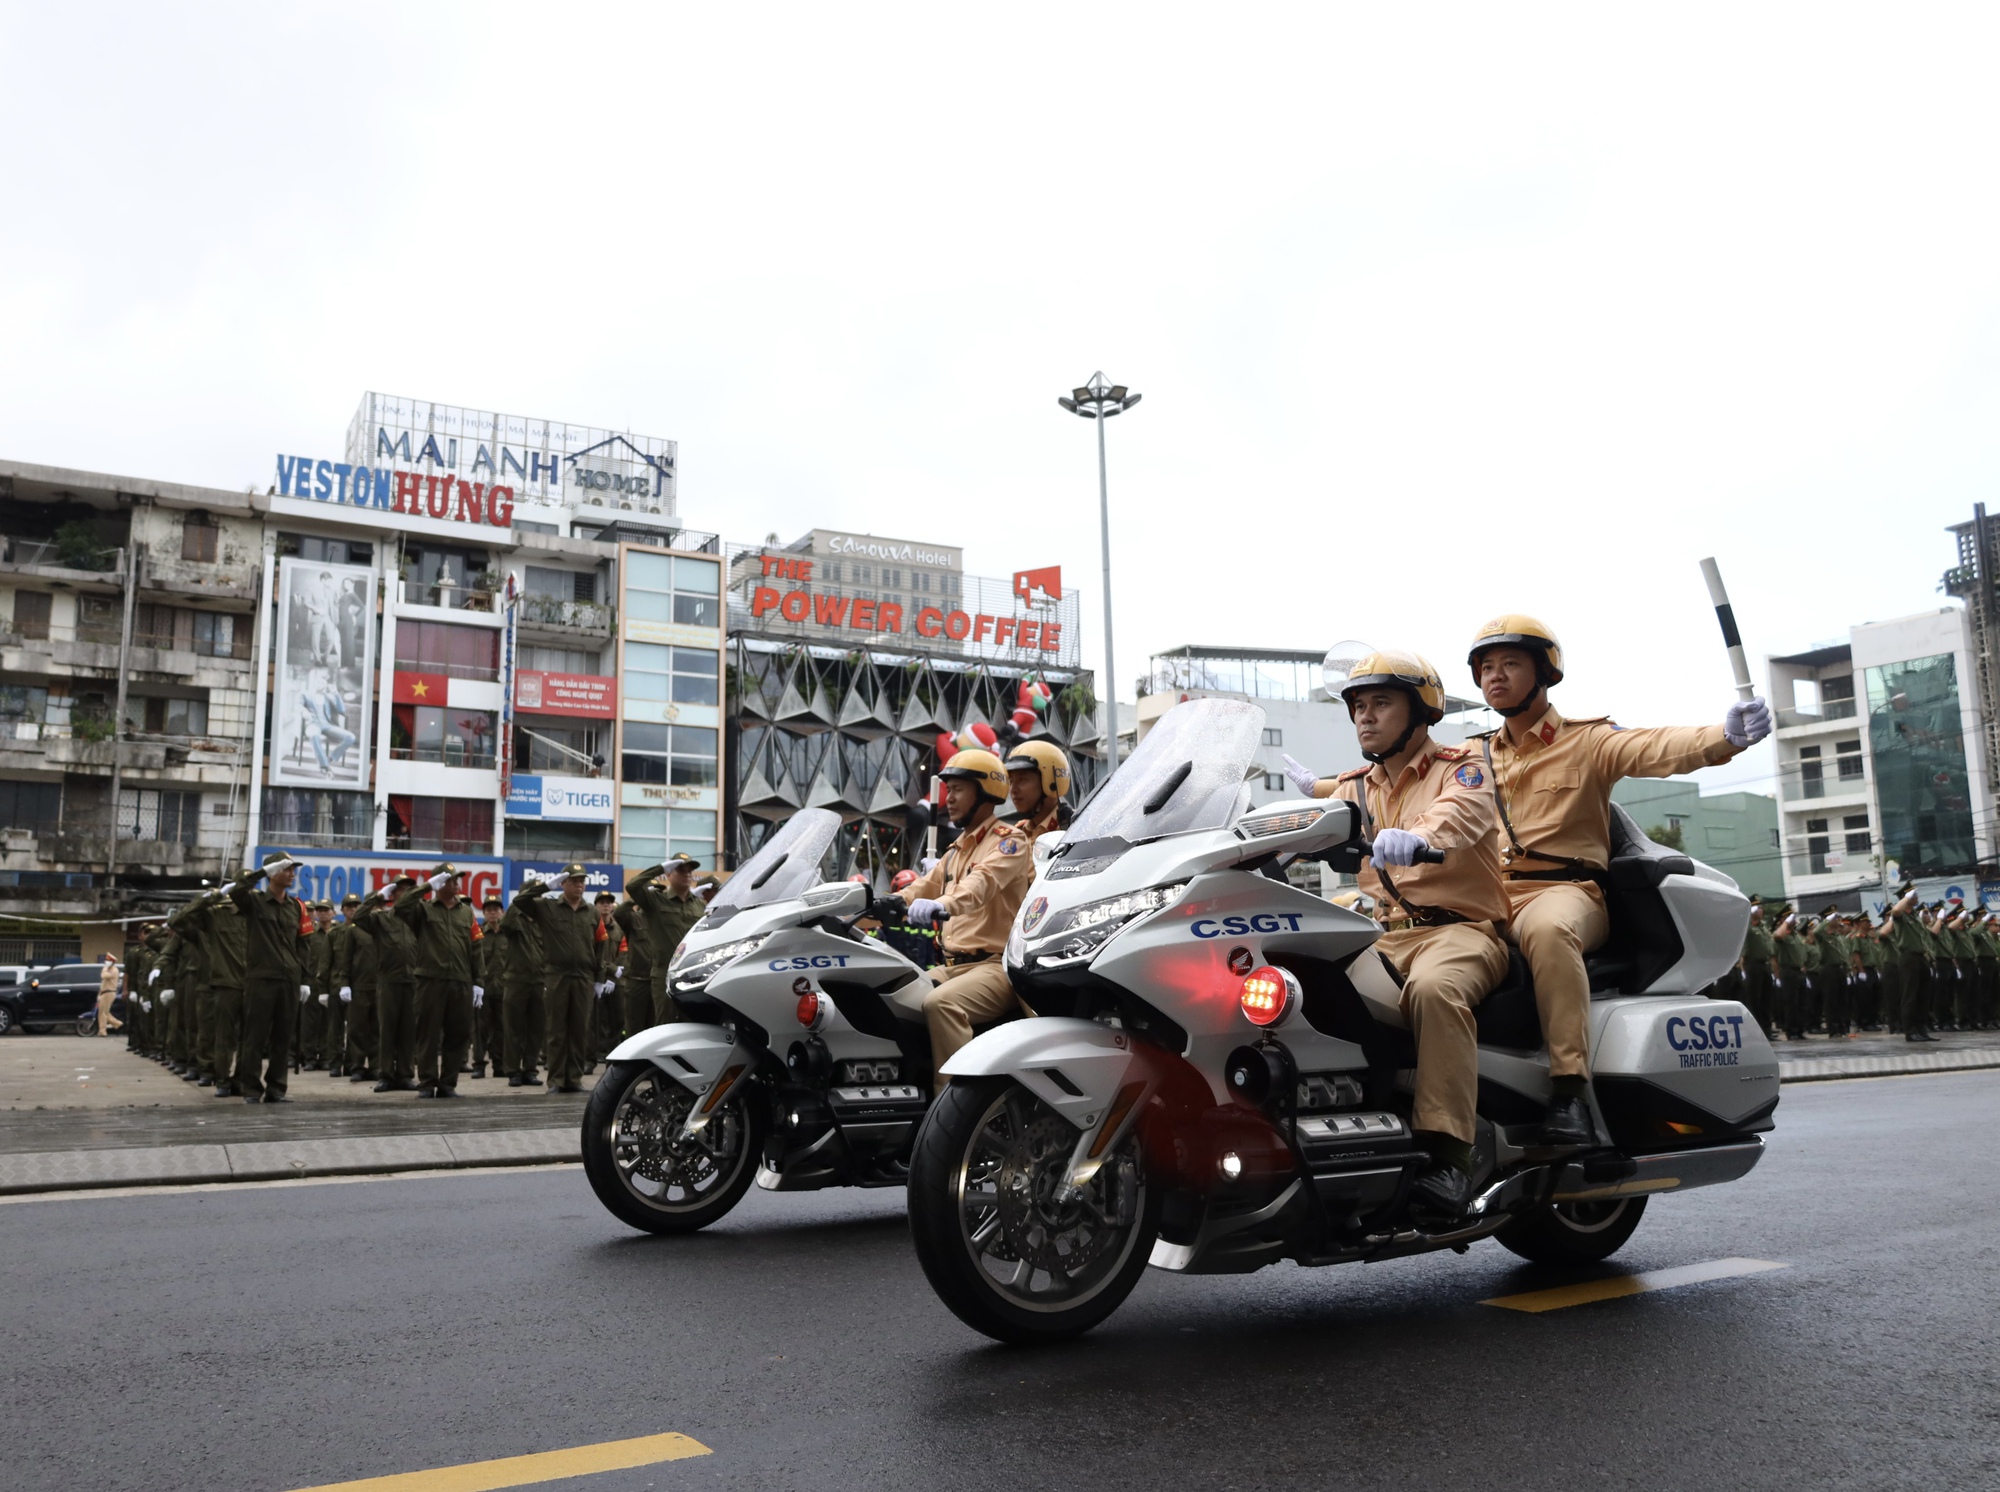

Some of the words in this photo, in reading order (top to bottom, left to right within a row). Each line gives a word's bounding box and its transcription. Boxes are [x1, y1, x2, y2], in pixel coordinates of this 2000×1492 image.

[377, 427, 457, 469] MAI
[471, 444, 558, 484] ANH
[277, 454, 391, 510] VESTON
[391, 471, 514, 527] HƯNG
[575, 468, 649, 497] HOME
[759, 555, 813, 581] THE
[916, 550, 951, 566] Hotel
[752, 586, 903, 633] POWER
[916, 606, 1062, 652] COFFEE
[565, 792, 610, 807] TIGER
[523, 868, 609, 886] Pannic
[1190, 913, 1303, 938] C.S.G.T
[769, 955, 850, 971] C.S.G.T
[1666, 1015, 1743, 1051] C.S.G.T
[1679, 1053, 1712, 1068] TRAFFIC
[1713, 1051, 1739, 1067] POLICE
